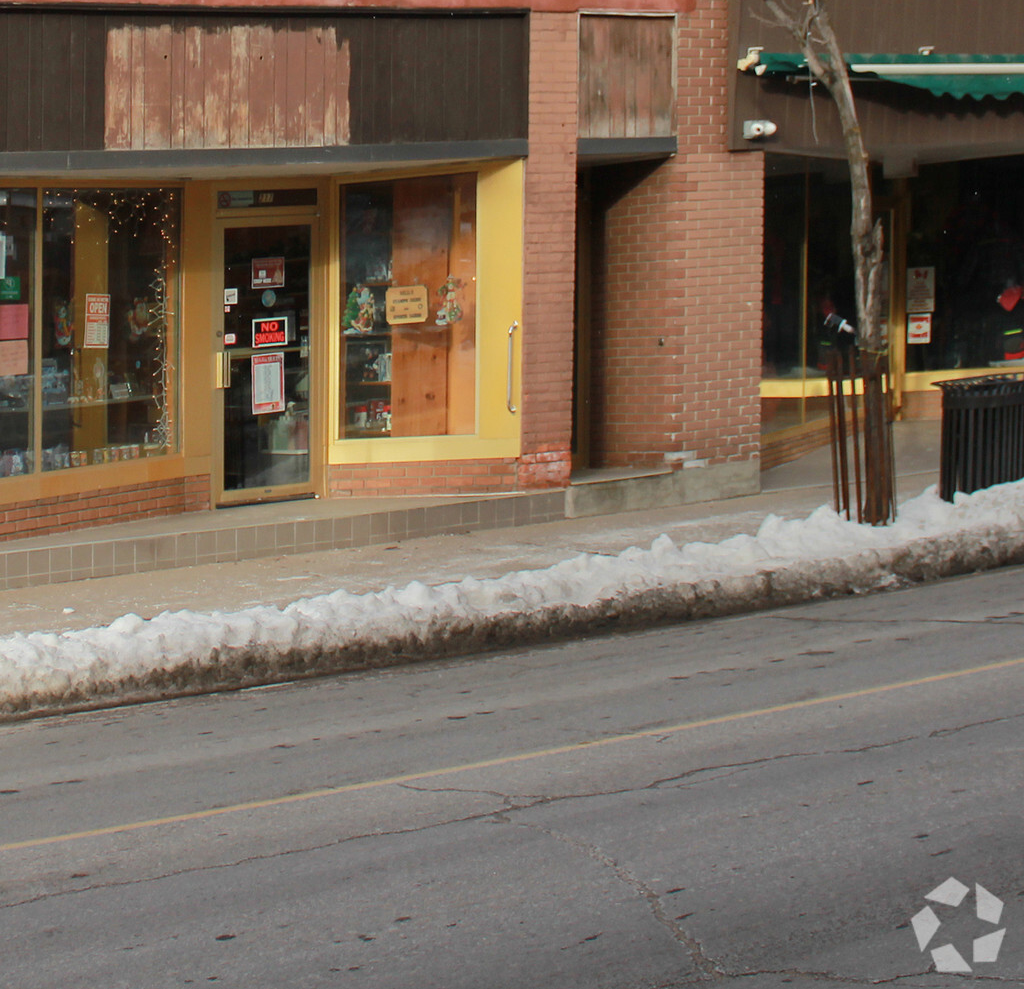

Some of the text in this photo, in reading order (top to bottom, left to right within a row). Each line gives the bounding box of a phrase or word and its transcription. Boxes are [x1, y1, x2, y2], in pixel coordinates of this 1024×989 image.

[89, 302, 108, 313] OPEN
[260, 321, 279, 332] NO
[255, 331, 285, 344] SMOKING
